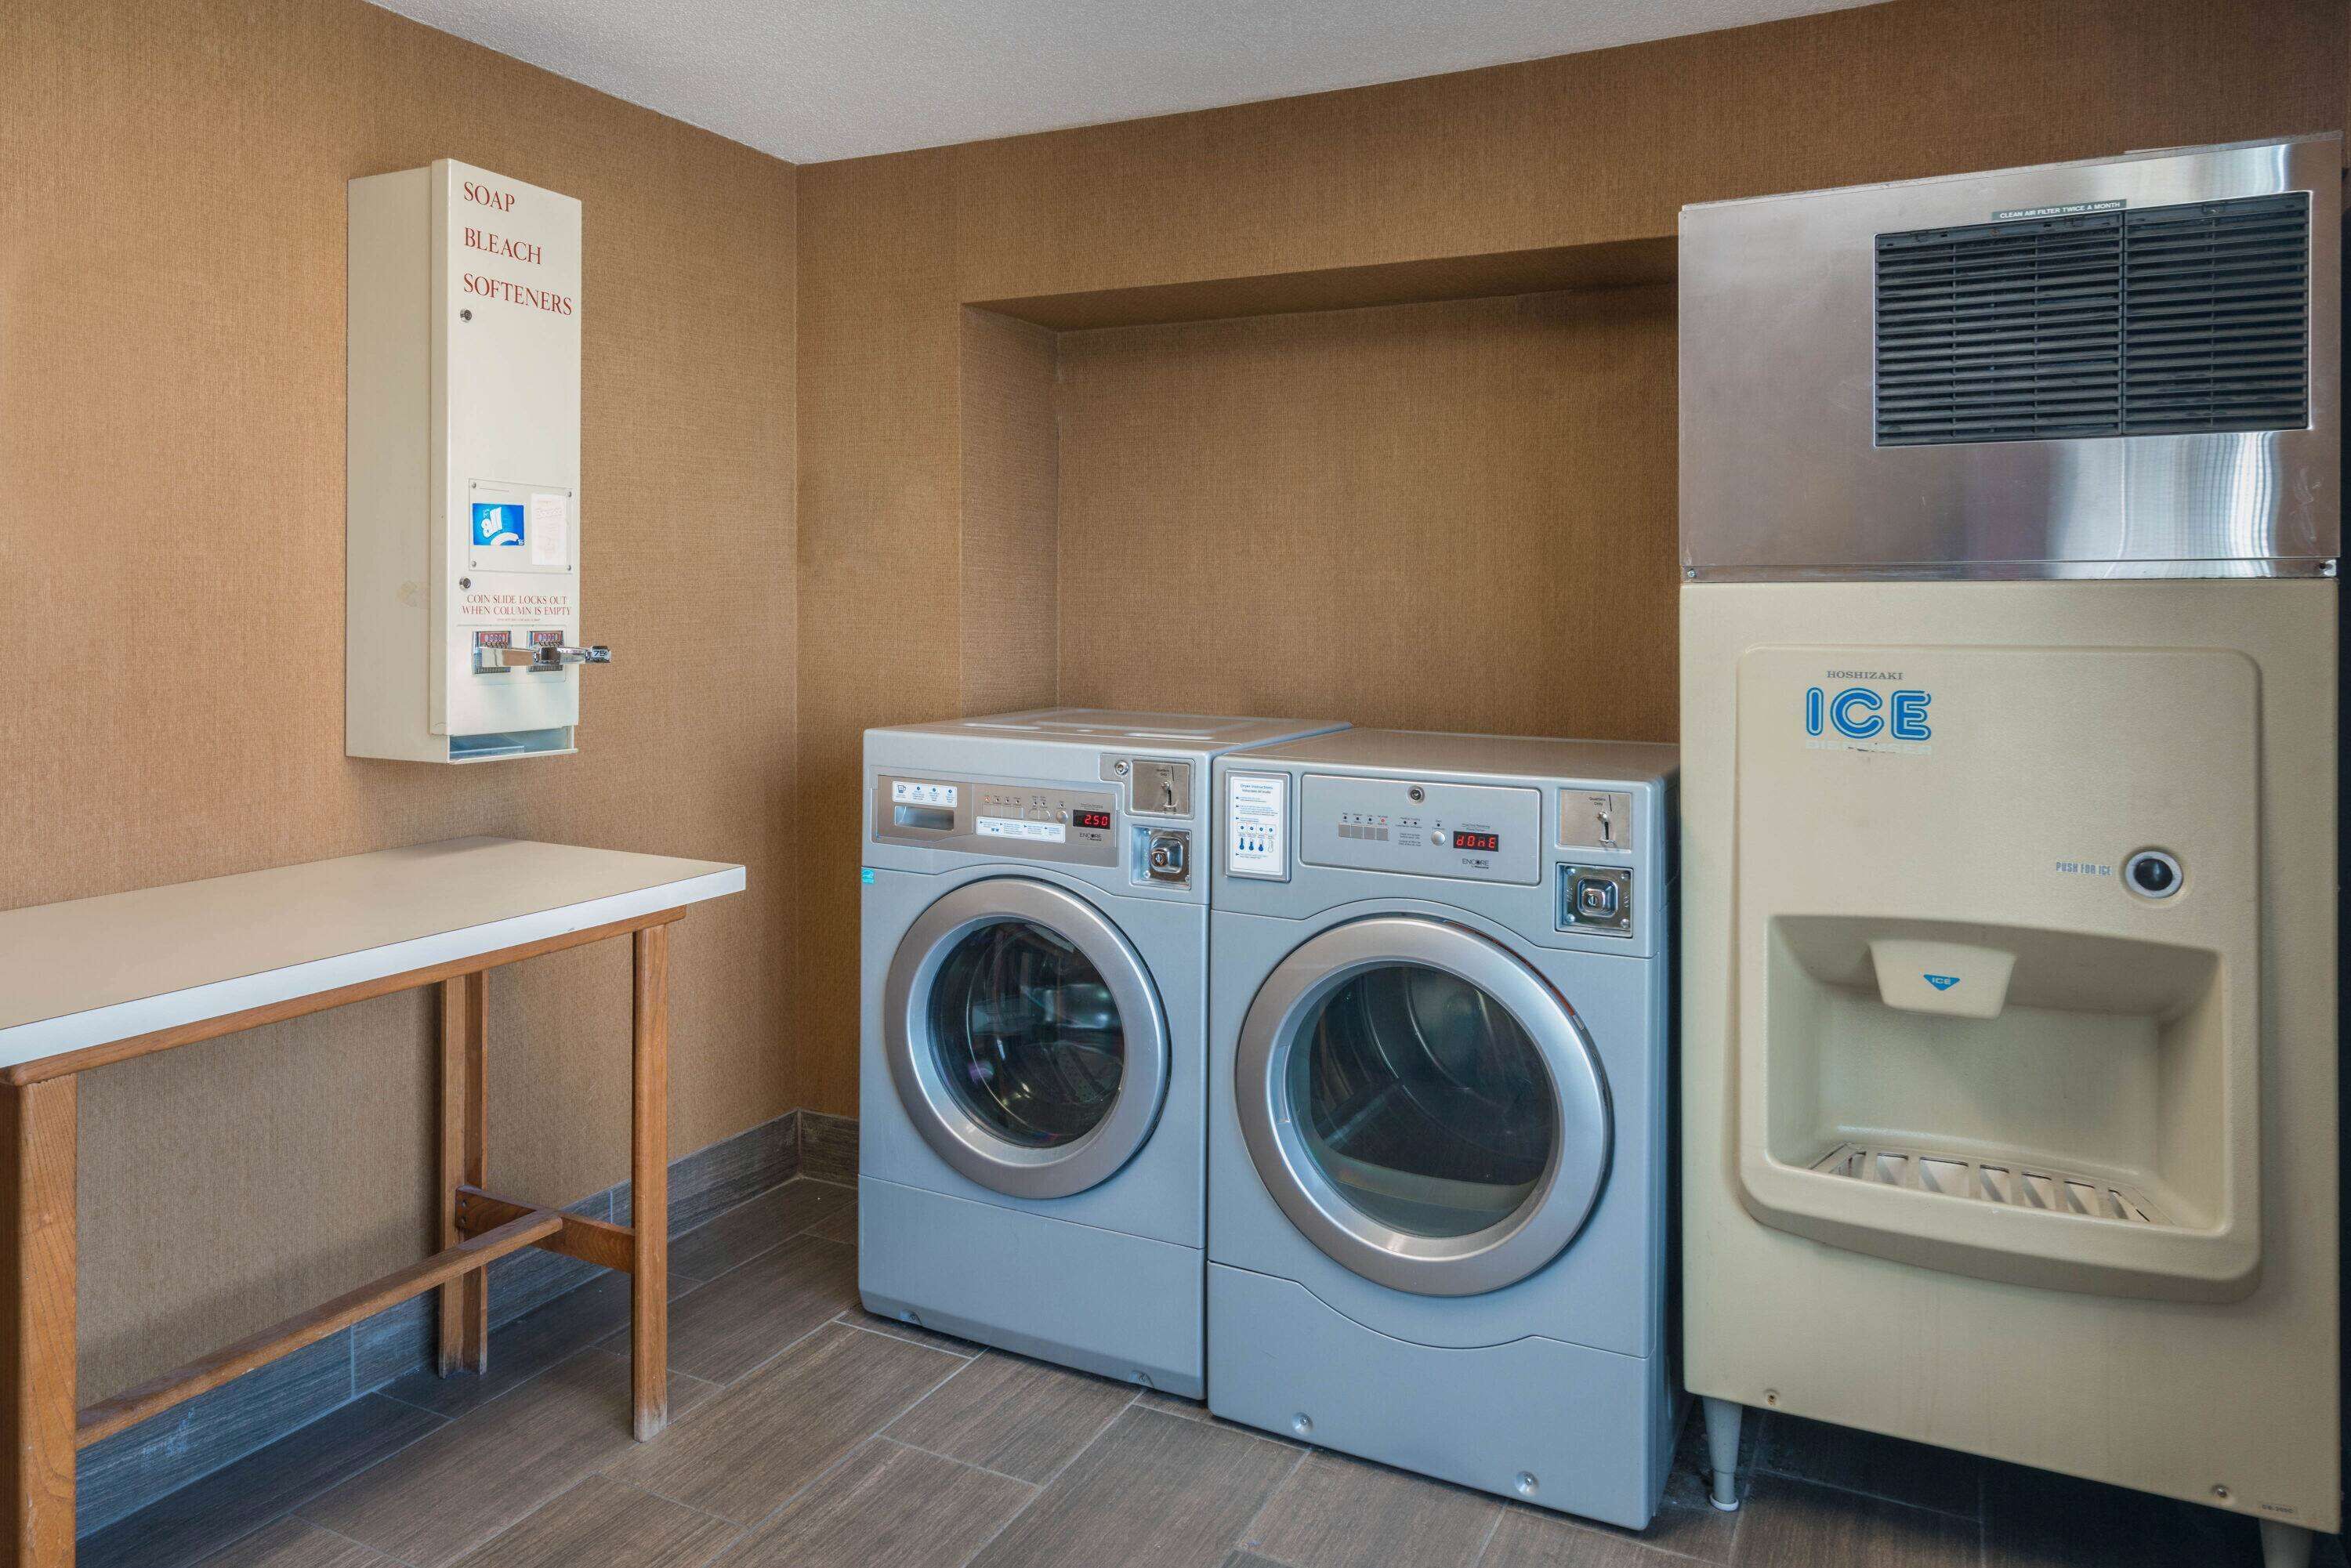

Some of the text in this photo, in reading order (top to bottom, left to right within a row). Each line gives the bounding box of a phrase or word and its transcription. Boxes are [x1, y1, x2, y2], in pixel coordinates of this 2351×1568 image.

[464, 181, 515, 212] SOAP
[464, 226, 542, 264] BLEACH
[463, 273, 572, 316] SOFTENERS
[466, 595, 567, 605] COIN SLIDE LOCKS OUT
[462, 606, 571, 616] WHEN COLUMN IS EMPTY
[1827, 671, 1905, 680] HOSHIZAKI
[1806, 687, 1932, 741] ICE
[1085, 814, 1108, 826] 250
[2056, 861, 2111, 876] PUSH FOR ICE
